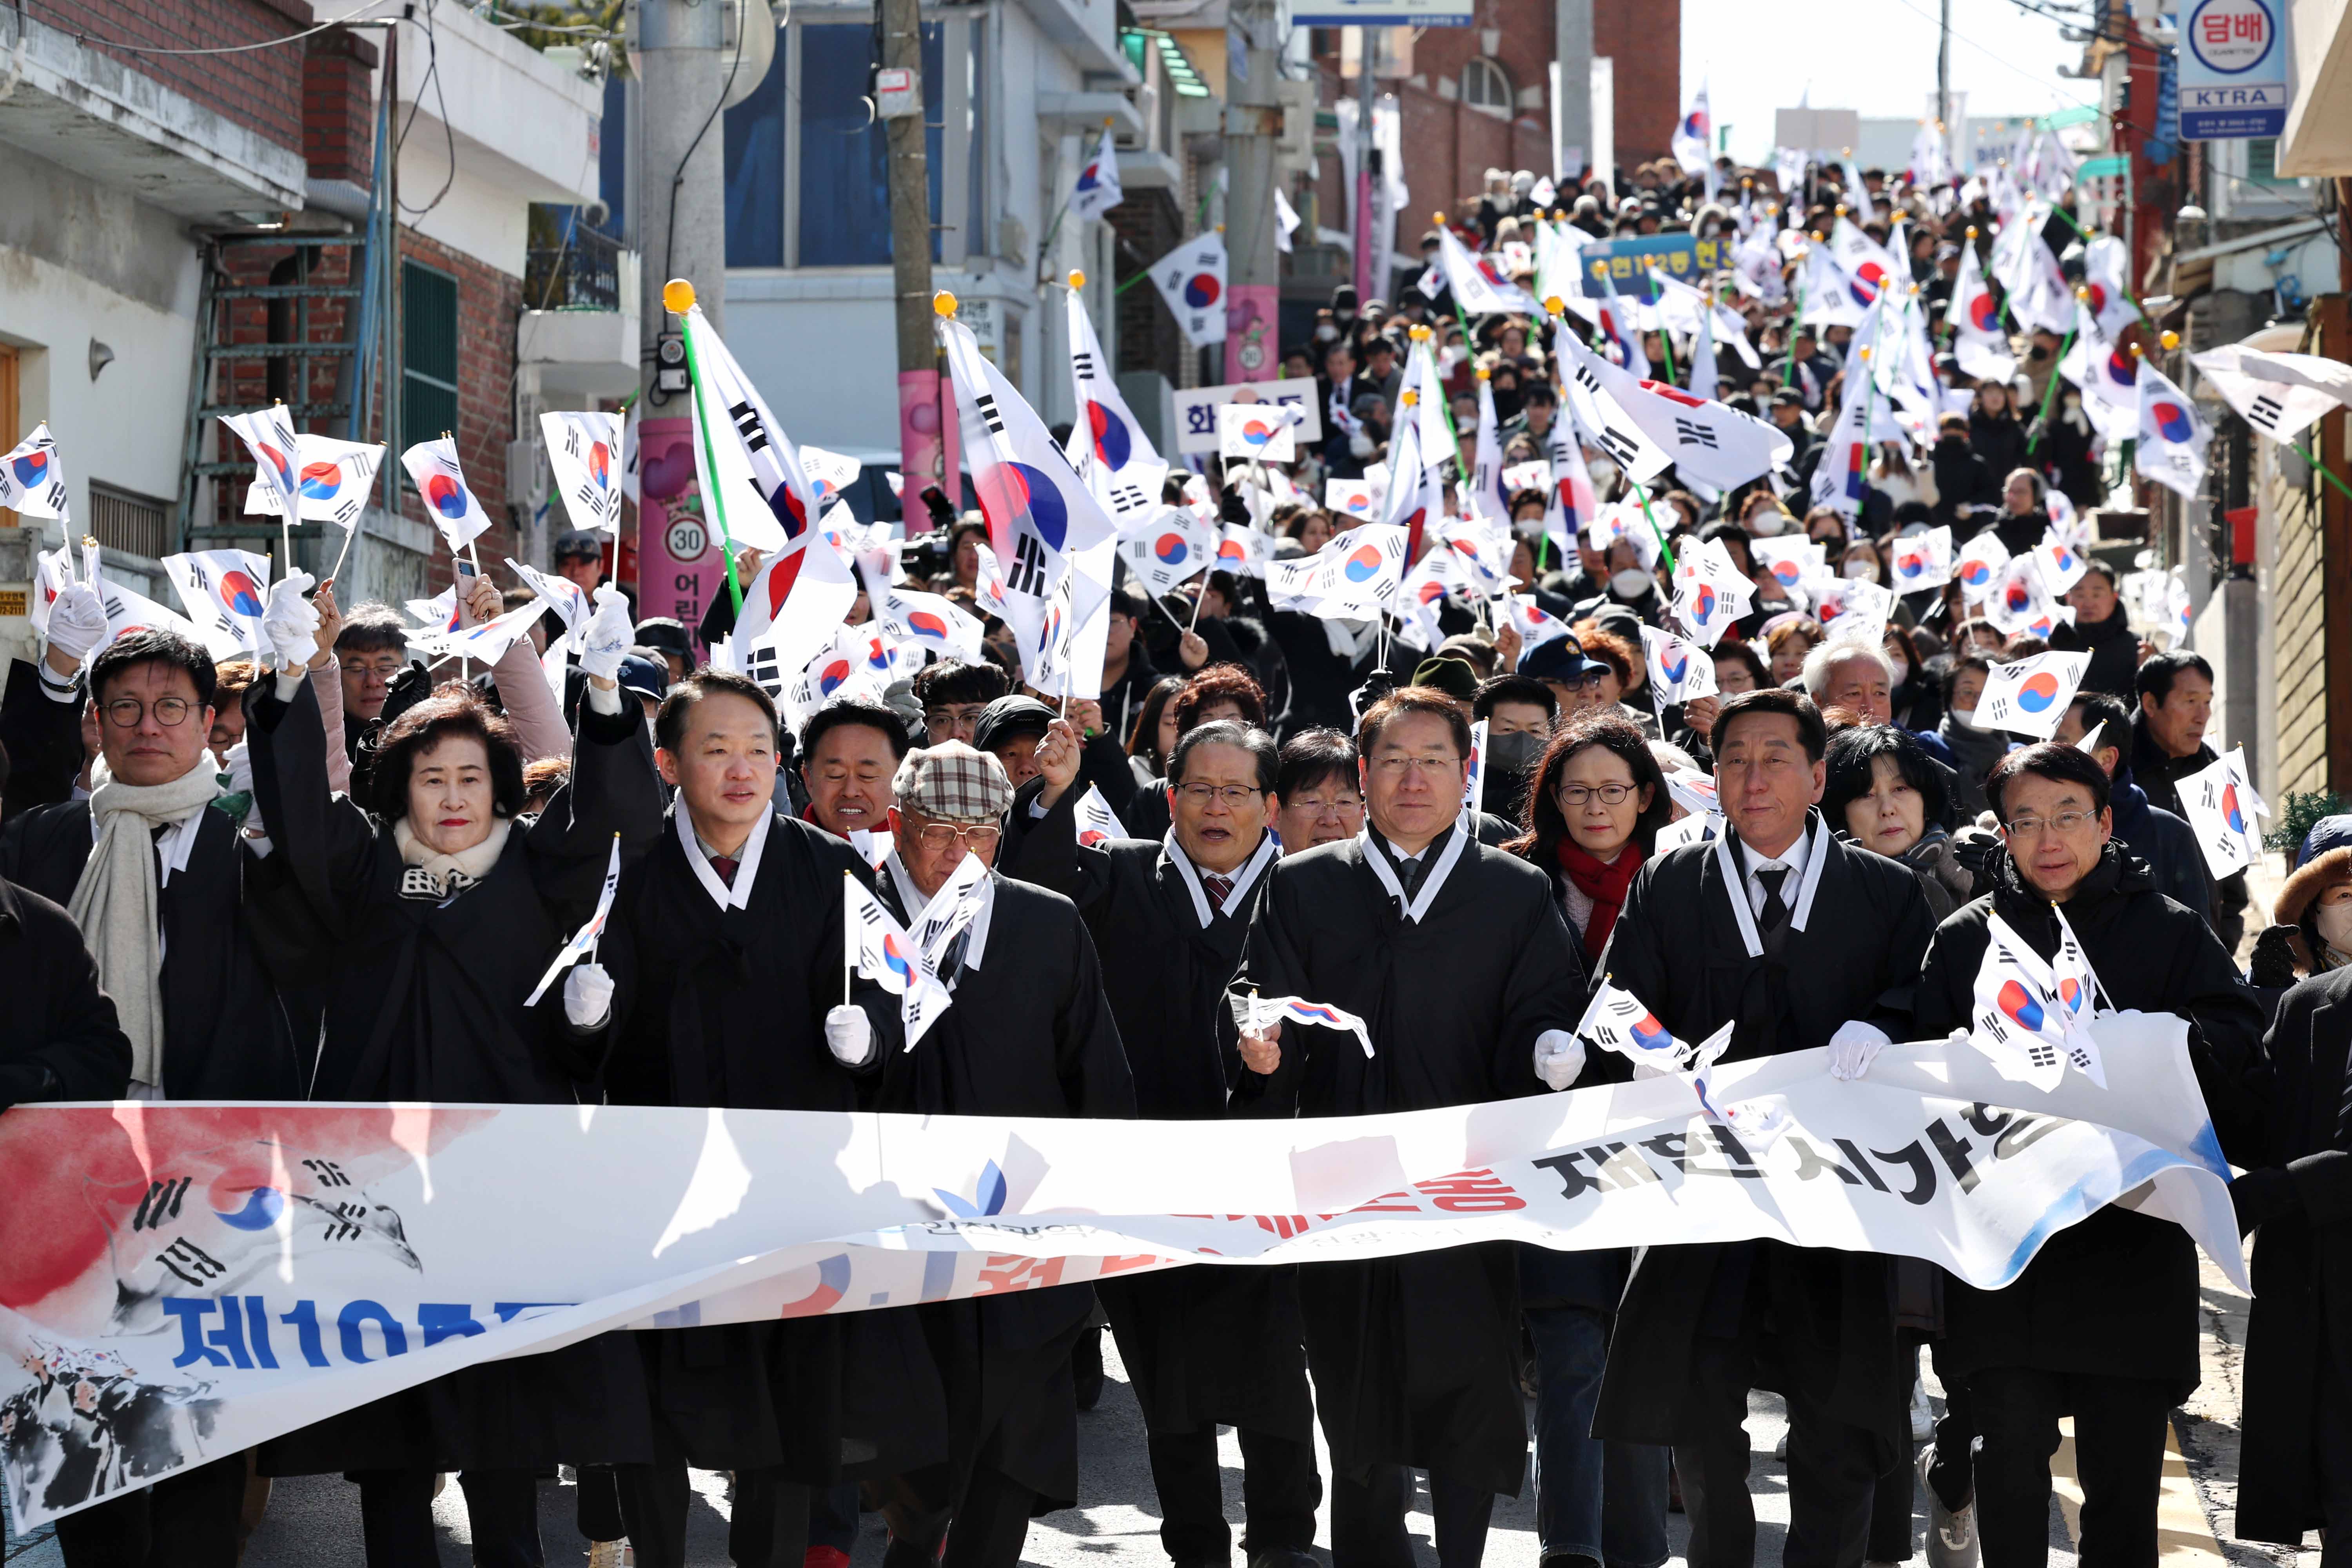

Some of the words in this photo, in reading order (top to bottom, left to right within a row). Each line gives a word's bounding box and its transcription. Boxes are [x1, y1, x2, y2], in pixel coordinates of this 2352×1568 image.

[2202, 13, 2263, 44] 담배
[2197, 89, 2267, 105] KTRA
[675, 529, 699, 550] 30
[2232, 976, 2247, 986] K2
[1531, 1124, 1769, 1200] 재현
[162, 1295, 584, 1369] 제105
